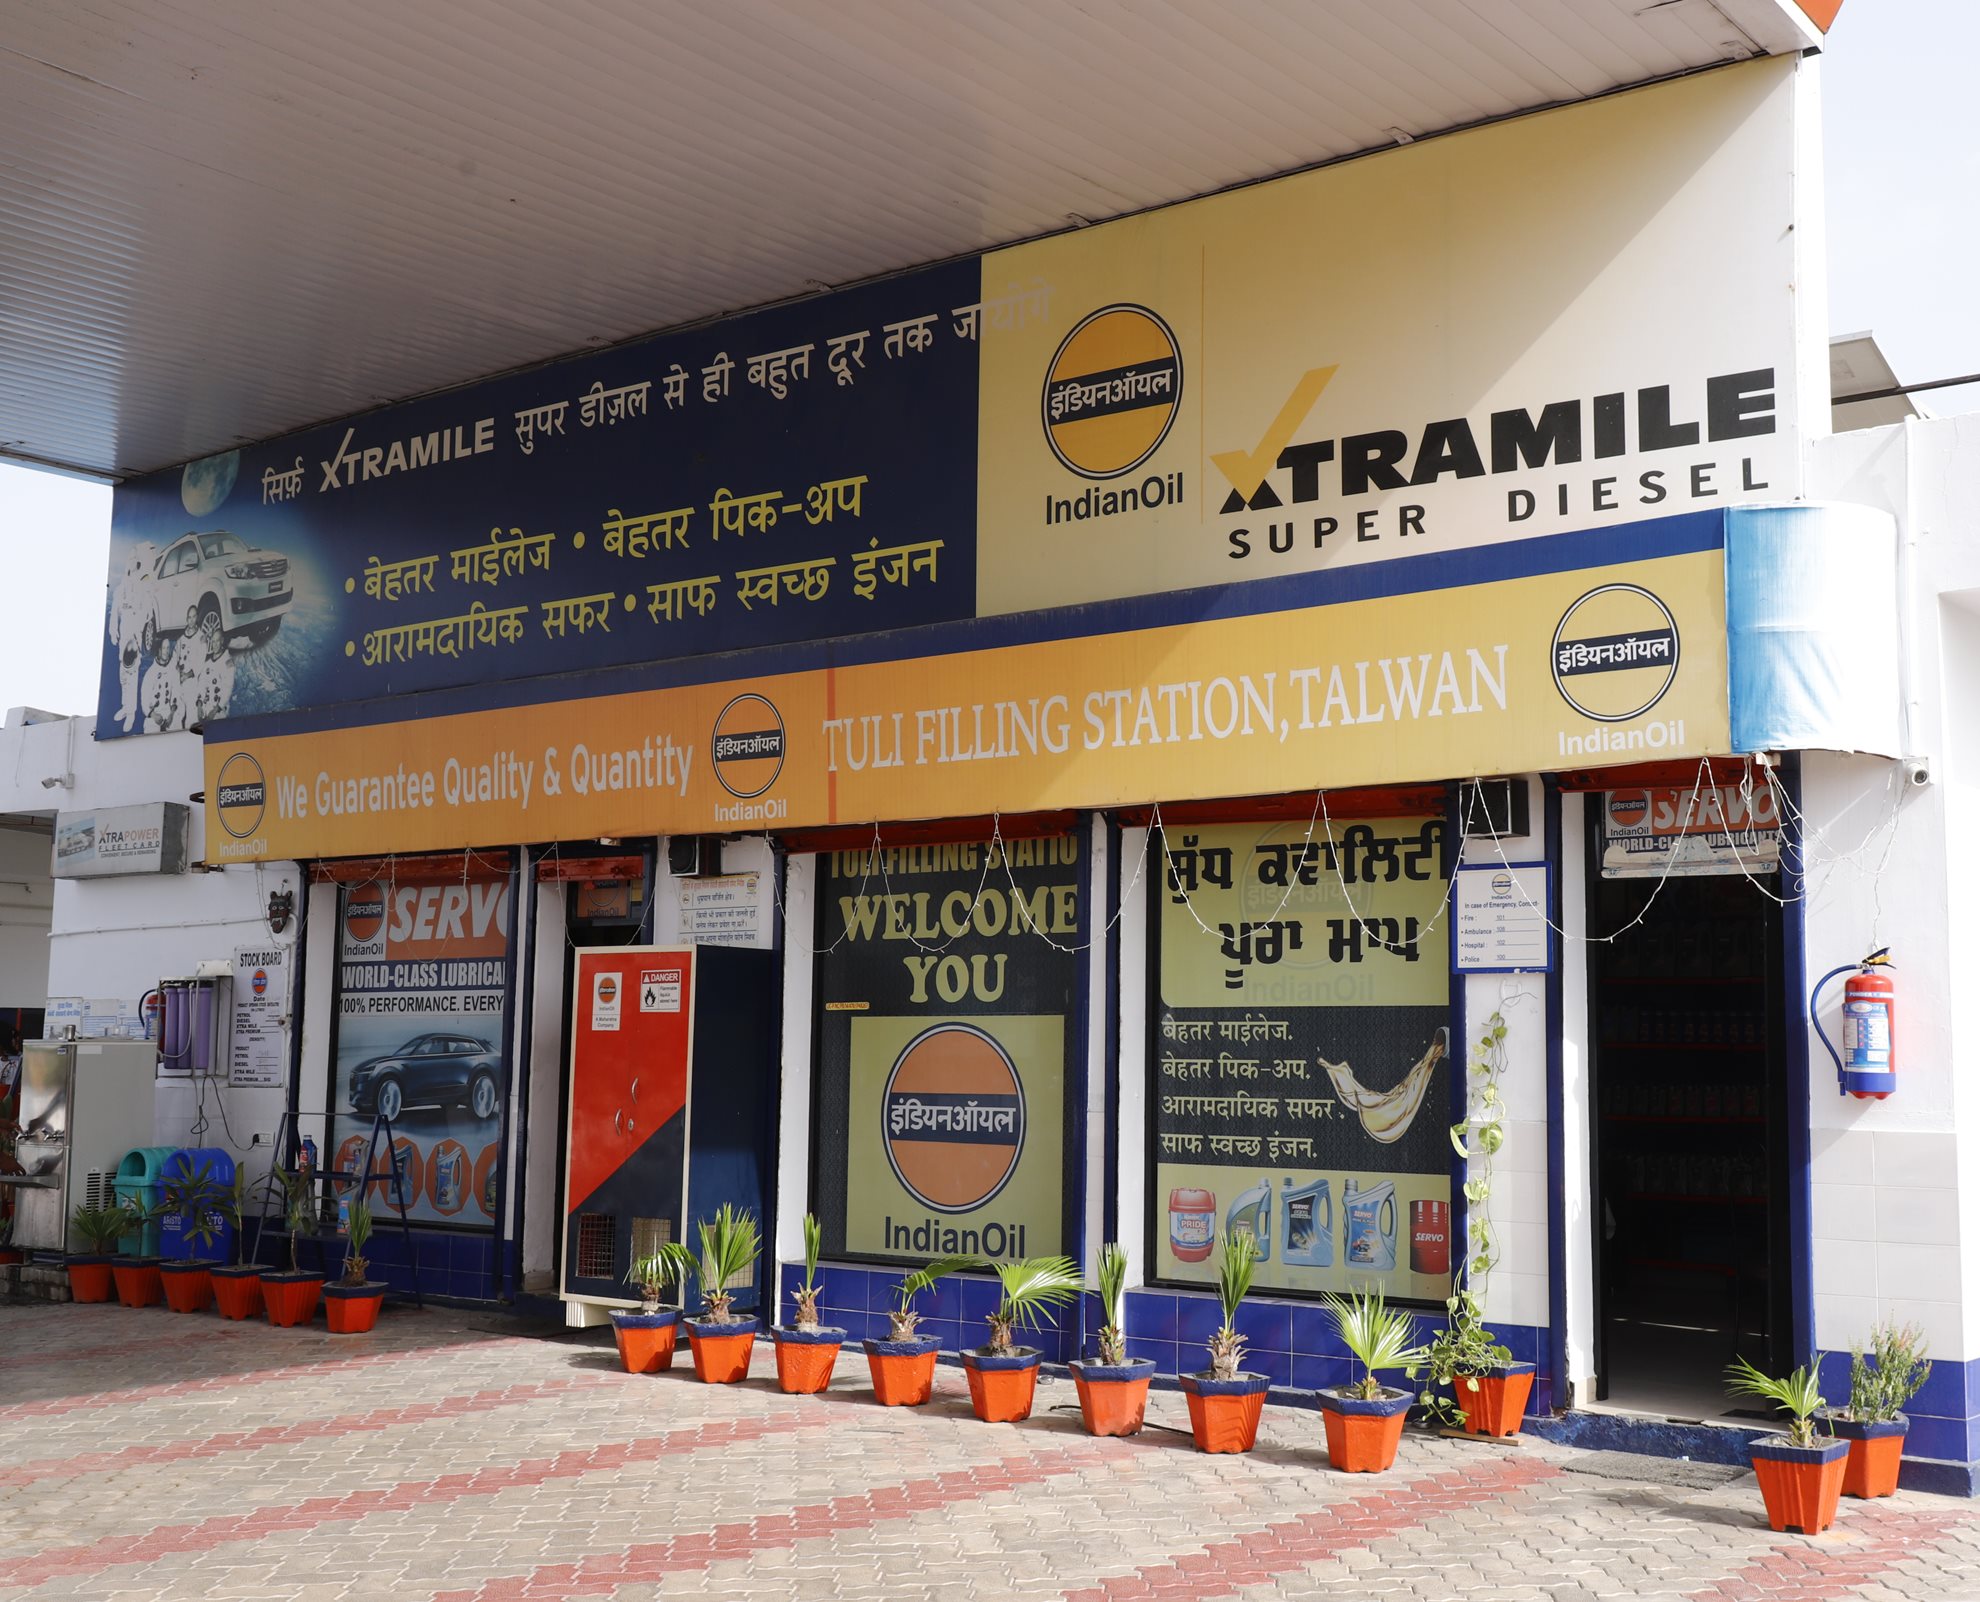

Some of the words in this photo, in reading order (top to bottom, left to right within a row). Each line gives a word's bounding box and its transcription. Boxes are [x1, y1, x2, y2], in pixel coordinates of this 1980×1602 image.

[319, 419, 494, 492] XTRAMILE
[515, 401, 570, 455] सुपर
[579, 380, 651, 428] डीज़ल
[663, 364, 689, 410] से
[701, 351, 735, 402] ही
[747, 343, 815, 399] बहुत
[827, 330, 870, 386] दूर
[883, 313, 938, 358] तक
[1050, 363, 1173, 420] इंडियनऑयल
[1211, 364, 1776, 514] XTRAMILE
[602, 509, 694, 559] बेहतर
[709, 474, 869, 541] पिक-अप
[1046, 472, 1184, 525] IndianOil
[1228, 503, 1427, 560] SUPER
[1507, 457, 1769, 523] DIESEL
[364, 557, 440, 601] बेहतर
[450, 528, 555, 585] माईलेज
[646, 575, 721, 625] साफ
[735, 556, 836, 608] स्वच्छ
[851, 537, 945, 601] इंजन
[361, 601, 528, 667] आरामदायिक
[541, 592, 616, 639] सफर
[1558, 633, 1670, 673] इंडियनऑयल
[823, 714, 904, 772] TULI
[915, 694, 1069, 766] FILLING
[1558, 719, 1686, 757] IndianOil
[276, 775, 308, 820] We
[315, 762, 435, 817] Guarantee
[442, 751, 534, 809] Quality
[542, 746, 563, 796] &
[570, 734, 694, 798] Quantity
[714, 798, 787, 823] IndianOil
[219, 838, 267, 858] IndianOil
[1610, 827, 1649, 837] IndianOil
[839, 884, 1077, 942] WELCOME
[344, 943, 383, 956] IndianOil
[1327, 917, 1420, 962] ਮਾਪ
[240, 953, 260, 968] STOCK
[261, 951, 282, 966] BOARD
[342, 963, 438, 989] WORLD-CLASS
[441, 961, 505, 987] LUBRICA
[651, 973, 678, 982] DANGER
[903, 953, 1008, 1003] YOU
[369, 996, 460, 1012] PERFORMANCE.
[463, 995, 504, 1011] EVERY
[1161, 1014, 1213, 1043] बेहतर
[1161, 1051, 1213, 1081] बेहतर
[890, 1098, 1016, 1135] इंडियनऑयल
[1161, 1090, 1279, 1120] आरामदायिक
[1160, 1133, 1203, 1154] साफ
[1208, 1134, 1261, 1157] स्वच्छ
[885, 1216, 1025, 1259] IndianOil
[1181, 1220, 1207, 1229] PRIDE
[1415, 1232, 1444, 1242] SERVO
